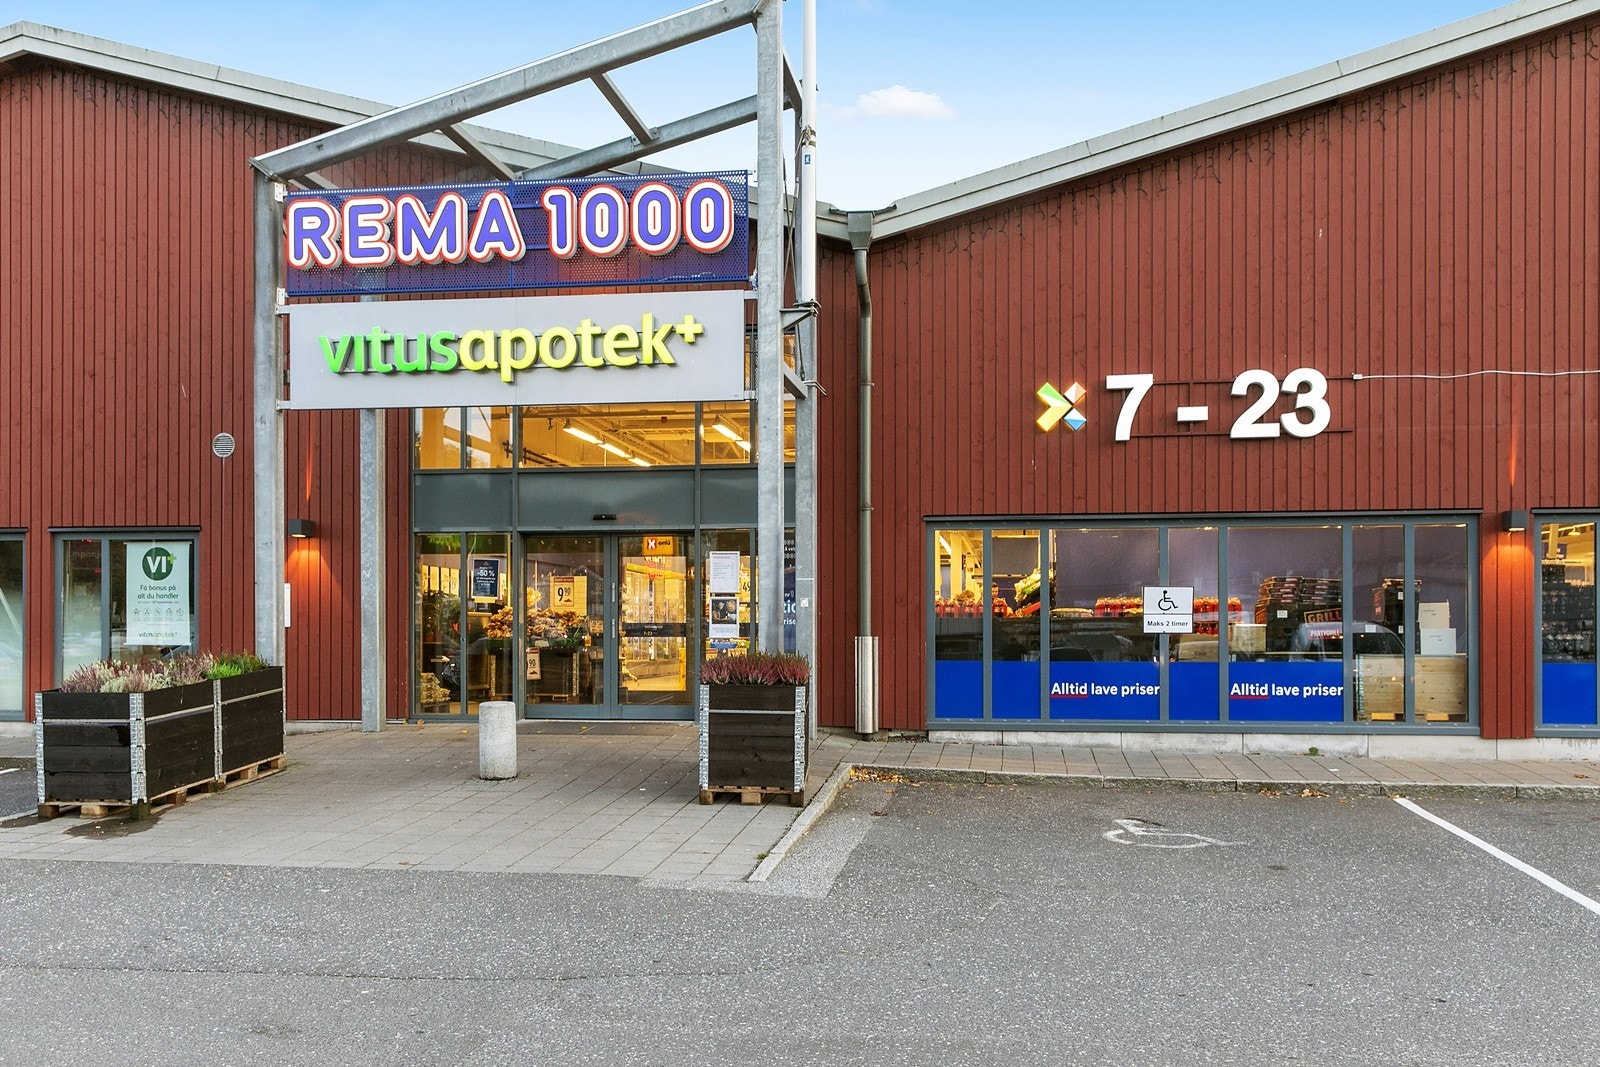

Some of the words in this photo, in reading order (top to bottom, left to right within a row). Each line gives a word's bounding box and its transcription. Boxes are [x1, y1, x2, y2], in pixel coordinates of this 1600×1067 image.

[286, 190, 526, 270] REMA
[541, 179, 735, 260] 1000
[1106, 373, 1154, 441] 7
[1177, 406, 1208, 422] -
[1230, 367, 1331, 439] 23
[168, 584, 176, 592] på
[1307, 611, 1342, 623] GRILL
[1051, 683, 1088, 695] Alltid
[1091, 683, 1118, 695] lave
[1121, 683, 1160, 698] priser
[1230, 683, 1269, 696] Alltid
[1271, 683, 1300, 696] lave
[1303, 683, 1344, 698] priser
